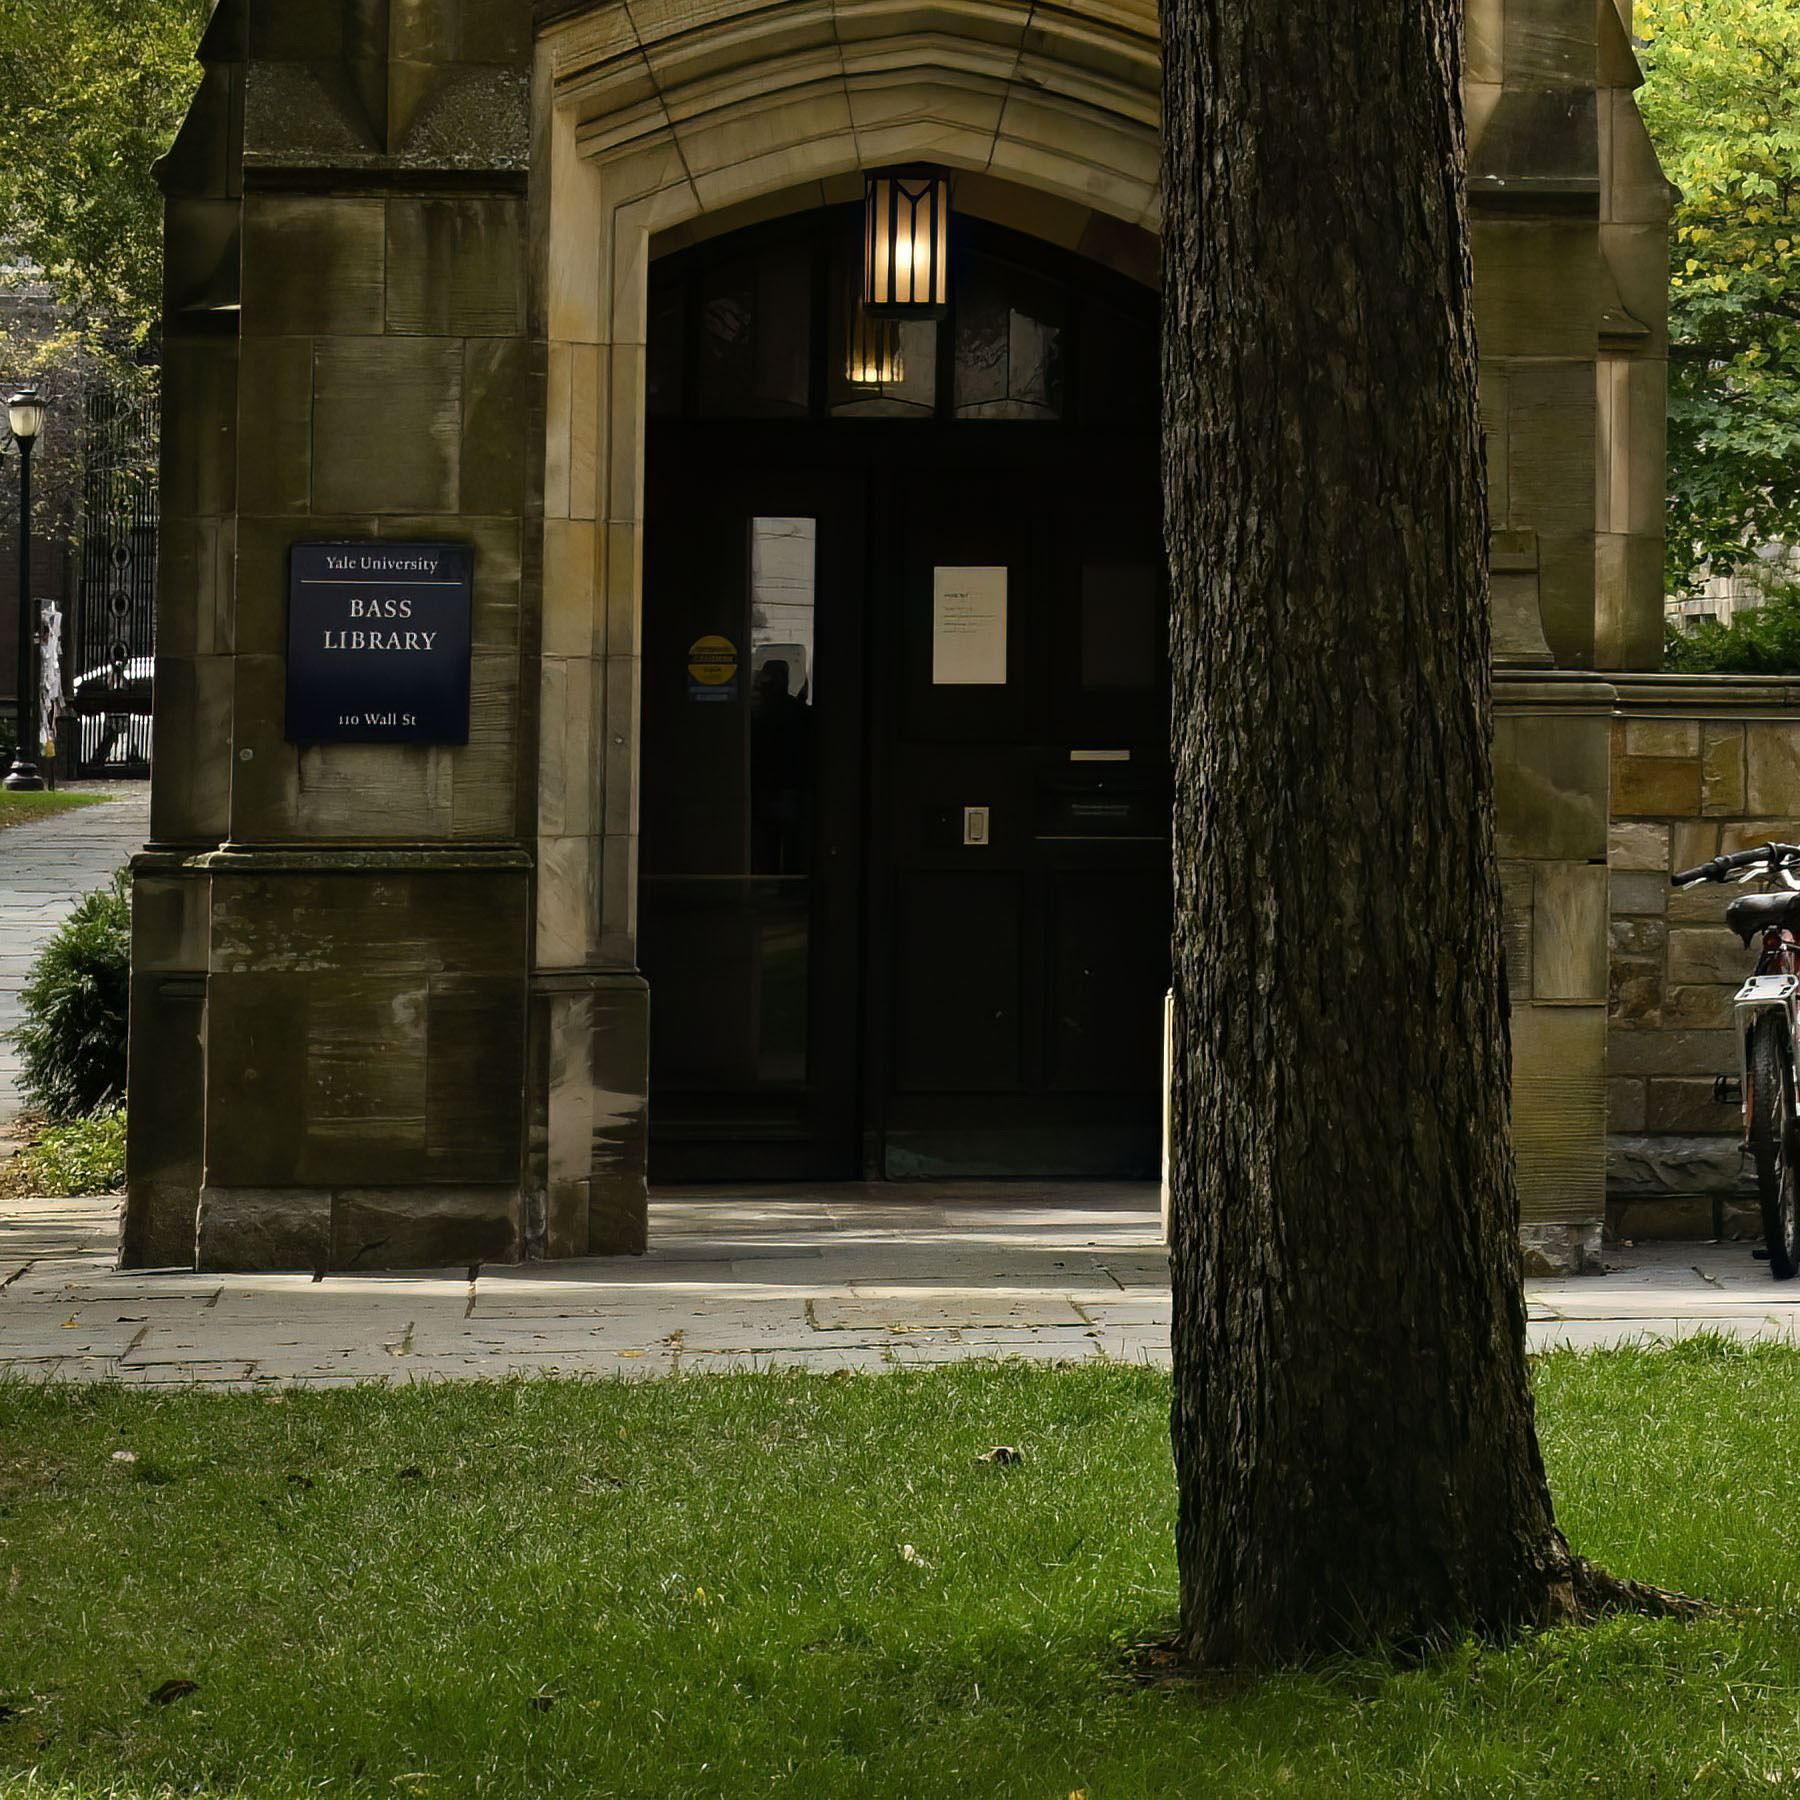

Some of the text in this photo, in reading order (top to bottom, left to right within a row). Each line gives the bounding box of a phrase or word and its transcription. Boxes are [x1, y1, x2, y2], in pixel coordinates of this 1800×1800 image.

[326, 555, 438, 575] Yale University
[350, 599, 412, 618] BASS
[324, 631, 437, 650] LIBRARY
[339, 712, 416, 726] 110 Wall St
